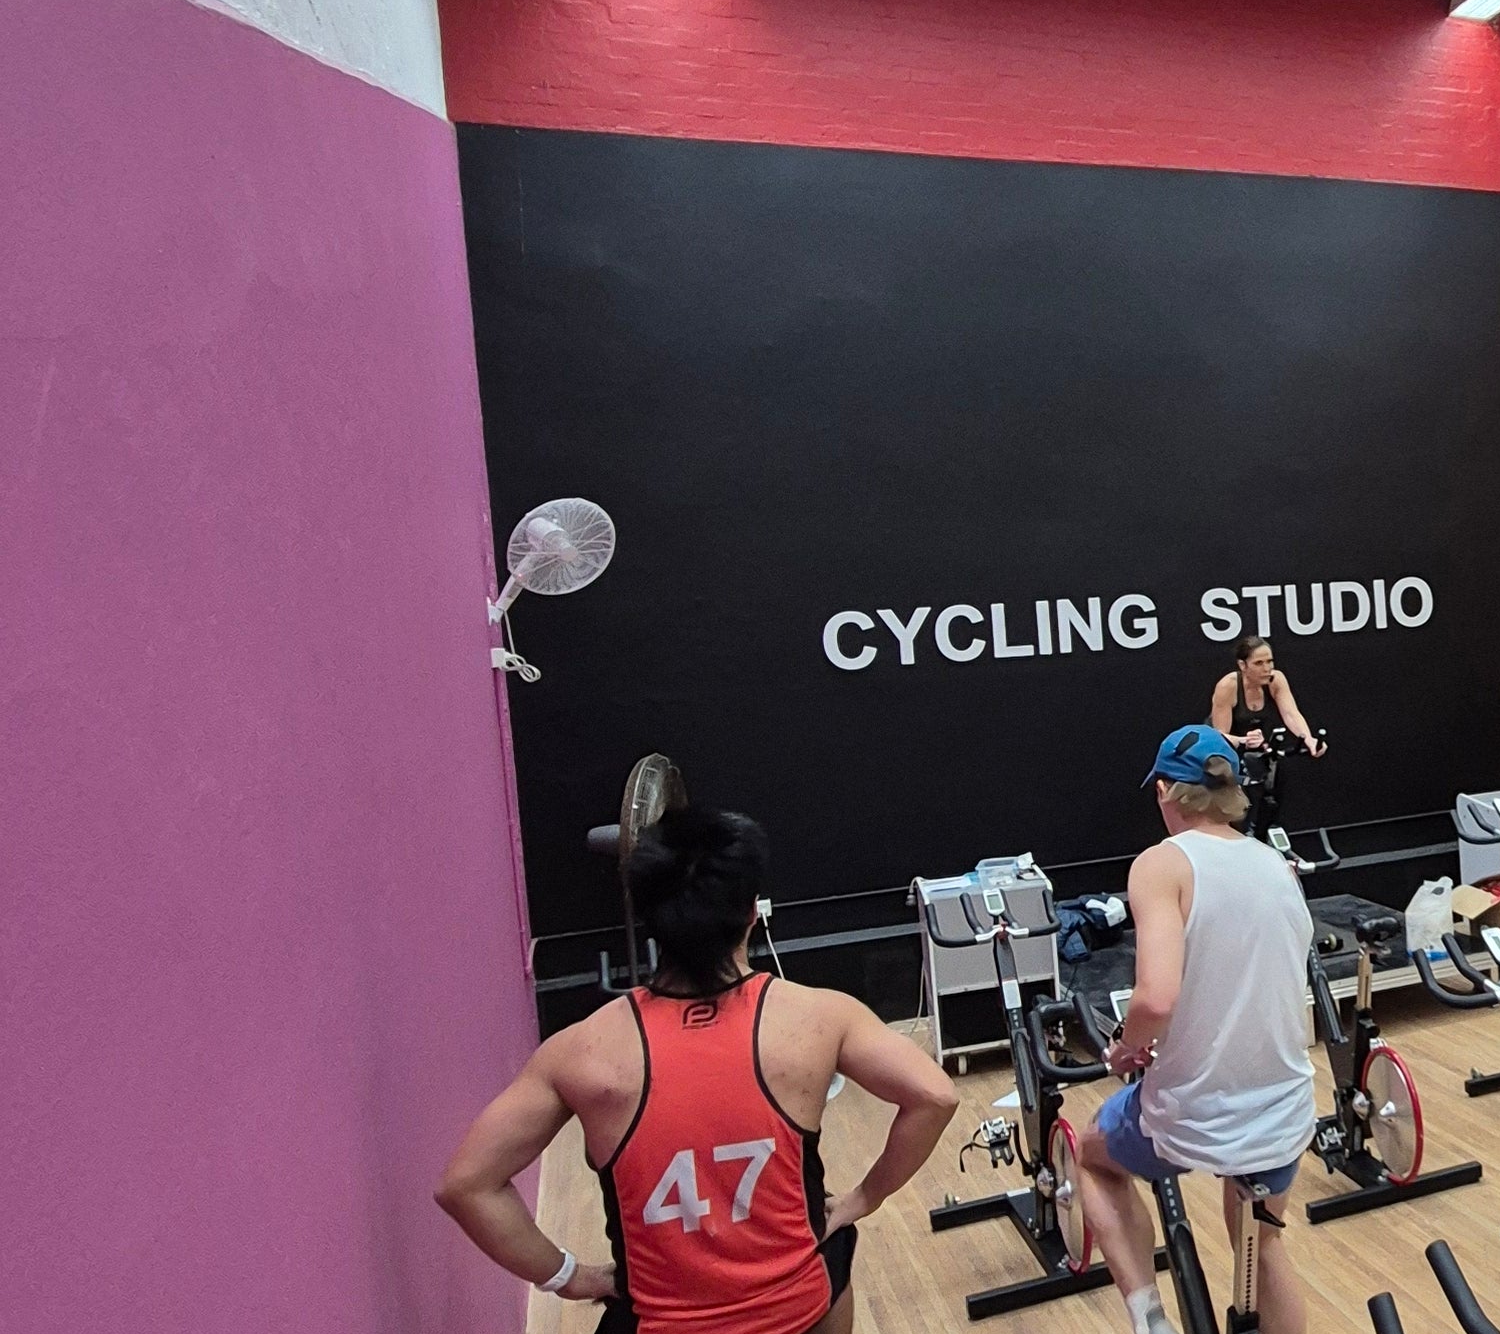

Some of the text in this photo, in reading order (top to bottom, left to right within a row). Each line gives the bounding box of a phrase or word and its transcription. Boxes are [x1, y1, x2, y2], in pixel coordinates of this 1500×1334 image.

[822, 576, 1435, 671] CYCLING STUDIO
[642, 1137, 776, 1234] 47
